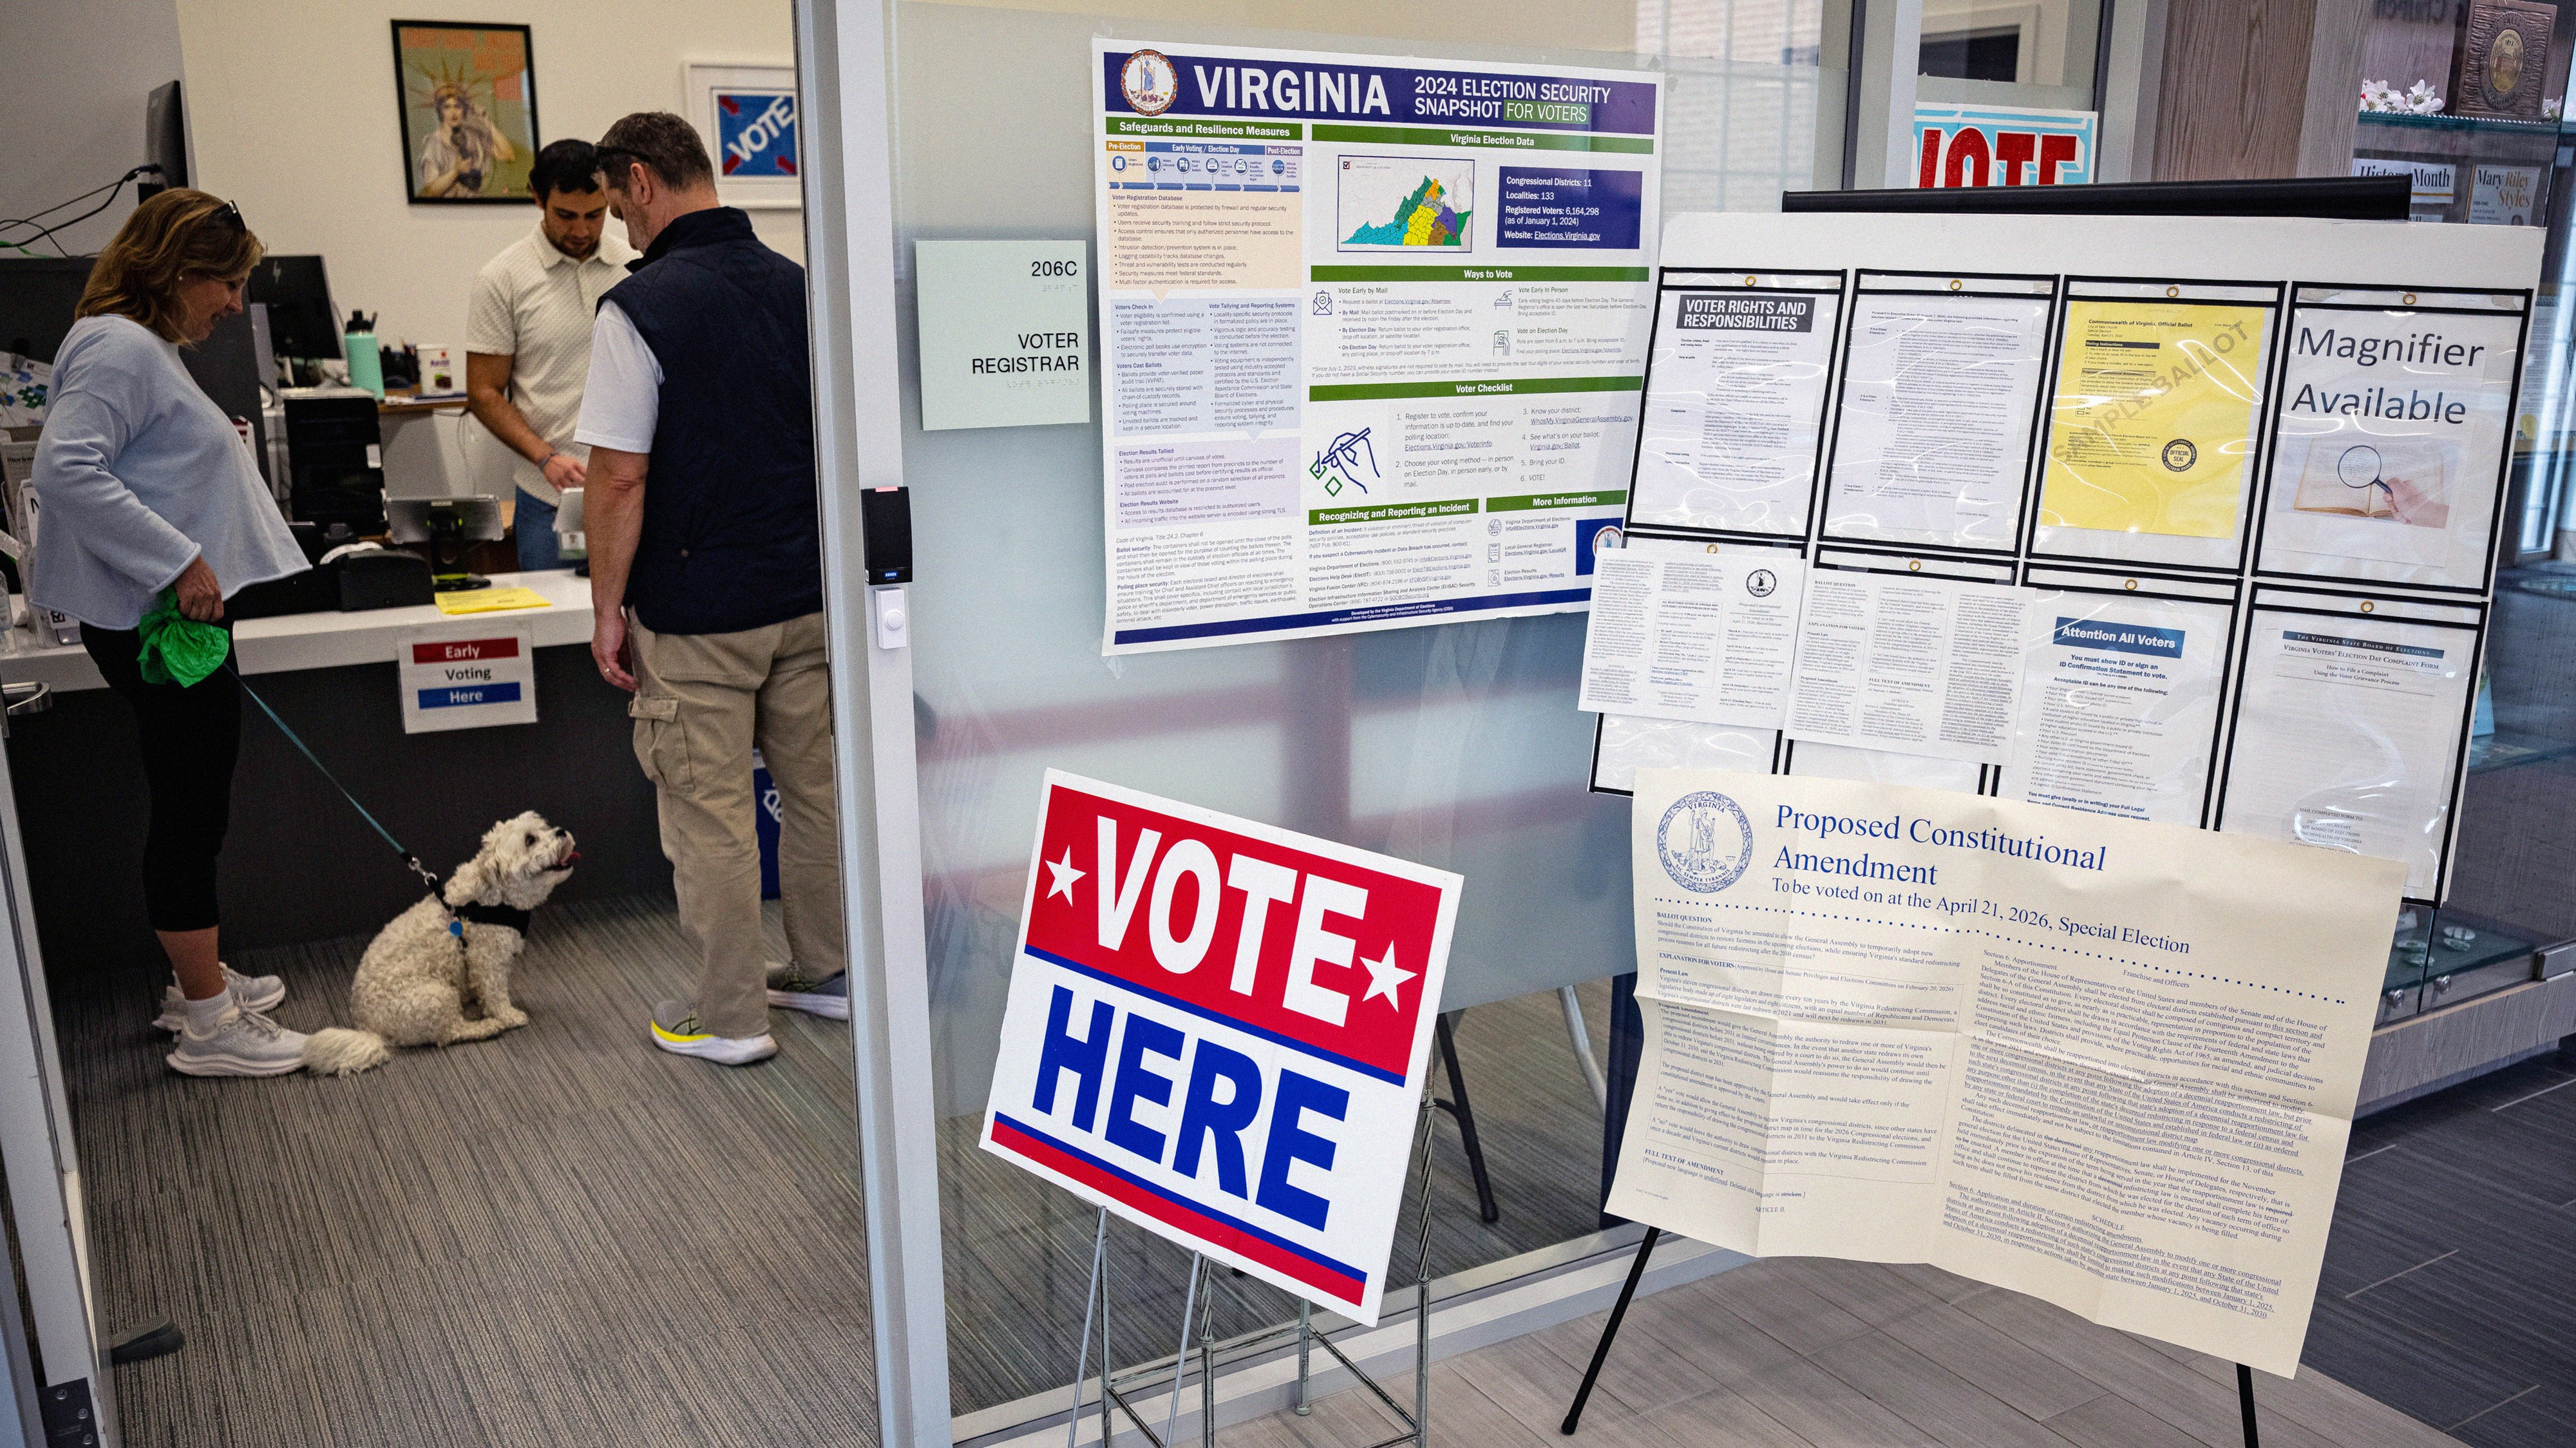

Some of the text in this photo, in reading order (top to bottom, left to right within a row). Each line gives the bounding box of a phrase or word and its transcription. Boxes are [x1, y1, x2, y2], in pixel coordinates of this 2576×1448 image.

[1193, 65, 1391, 115] VIRGINIA
[1414, 76, 1611, 104] 2024 ELECTION SECURITY
[1414, 97, 1587, 122] SNAPSHOT FOR VOTERS
[726, 97, 795, 161] VOTE
[1119, 121, 1291, 137] Safeguards and Resilience Measures
[1450, 134, 1535, 146] Virginia Election Data
[1919, 127, 2077, 188] OT
[1506, 176, 1592, 187] Congressional Districts: 11
[2412, 169, 2450, 187] Month
[2477, 169, 2530, 189] Mary Riley
[1506, 191, 1555, 200] Localities: 133
[2499, 190, 2530, 210] Styles
[1505, 205, 1600, 216] Registered Voters: 6,164,298
[1504, 216, 1579, 227] (as of January 1, 2024)
[1504, 230, 1601, 242] Website: Elections.Virginia.gov
[1032, 261, 1077, 276] 206C
[1463, 269, 1513, 280] Ways to Vote
[1352, 287, 1367, 295] Early
[1686, 299, 1806, 316] VOTER RIGHTS AND
[1683, 314, 1798, 330] RESPONSIBILITIES
[1018, 333, 1079, 349] VOTER
[2297, 327, 2485, 367] Magnifier
[972, 356, 1079, 374] REGISTRAR
[2152, 320, 2249, 396] BALLOT
[1455, 383, 1513, 394] Voter Checklist
[2291, 384, 2467, 425] Available
[1529, 459, 1544, 467] Bring
[1533, 495, 1597, 506] More Information
[1319, 510, 1370, 522] Recognizing
[1370, 508, 1387, 518] and
[1388, 506, 1426, 518] Reporting
[1439, 503, 1470, 513] Incident
[2061, 626, 2176, 649] Attention All Voters
[446, 643, 480, 660] Early
[445, 667, 492, 681] Voting
[2067, 662, 2108, 672] Confirmation
[2109, 667, 2143, 677] Statement
[2135, 662, 2149, 670] sign
[450, 691, 483, 703] Here
[1688, 801, 1725, 813] VIRGINIA
[1776, 805, 2105, 871] Proposed Constitutional
[1774, 845, 1938, 886] Amendment
[1097, 815, 1368, 1028] VOTE
[1656, 912, 1712, 923] BALLOT QUESTION
[1772, 878, 2190, 953] To be voted on at the April 21, 2026, Special Election
[1032, 984, 1350, 1233] HERE
[1645, 1148, 1659, 1157] FULL
[1662, 1153, 1677, 1162] TEXT
[1687, 1161, 1724, 1176] AMENDMENT
